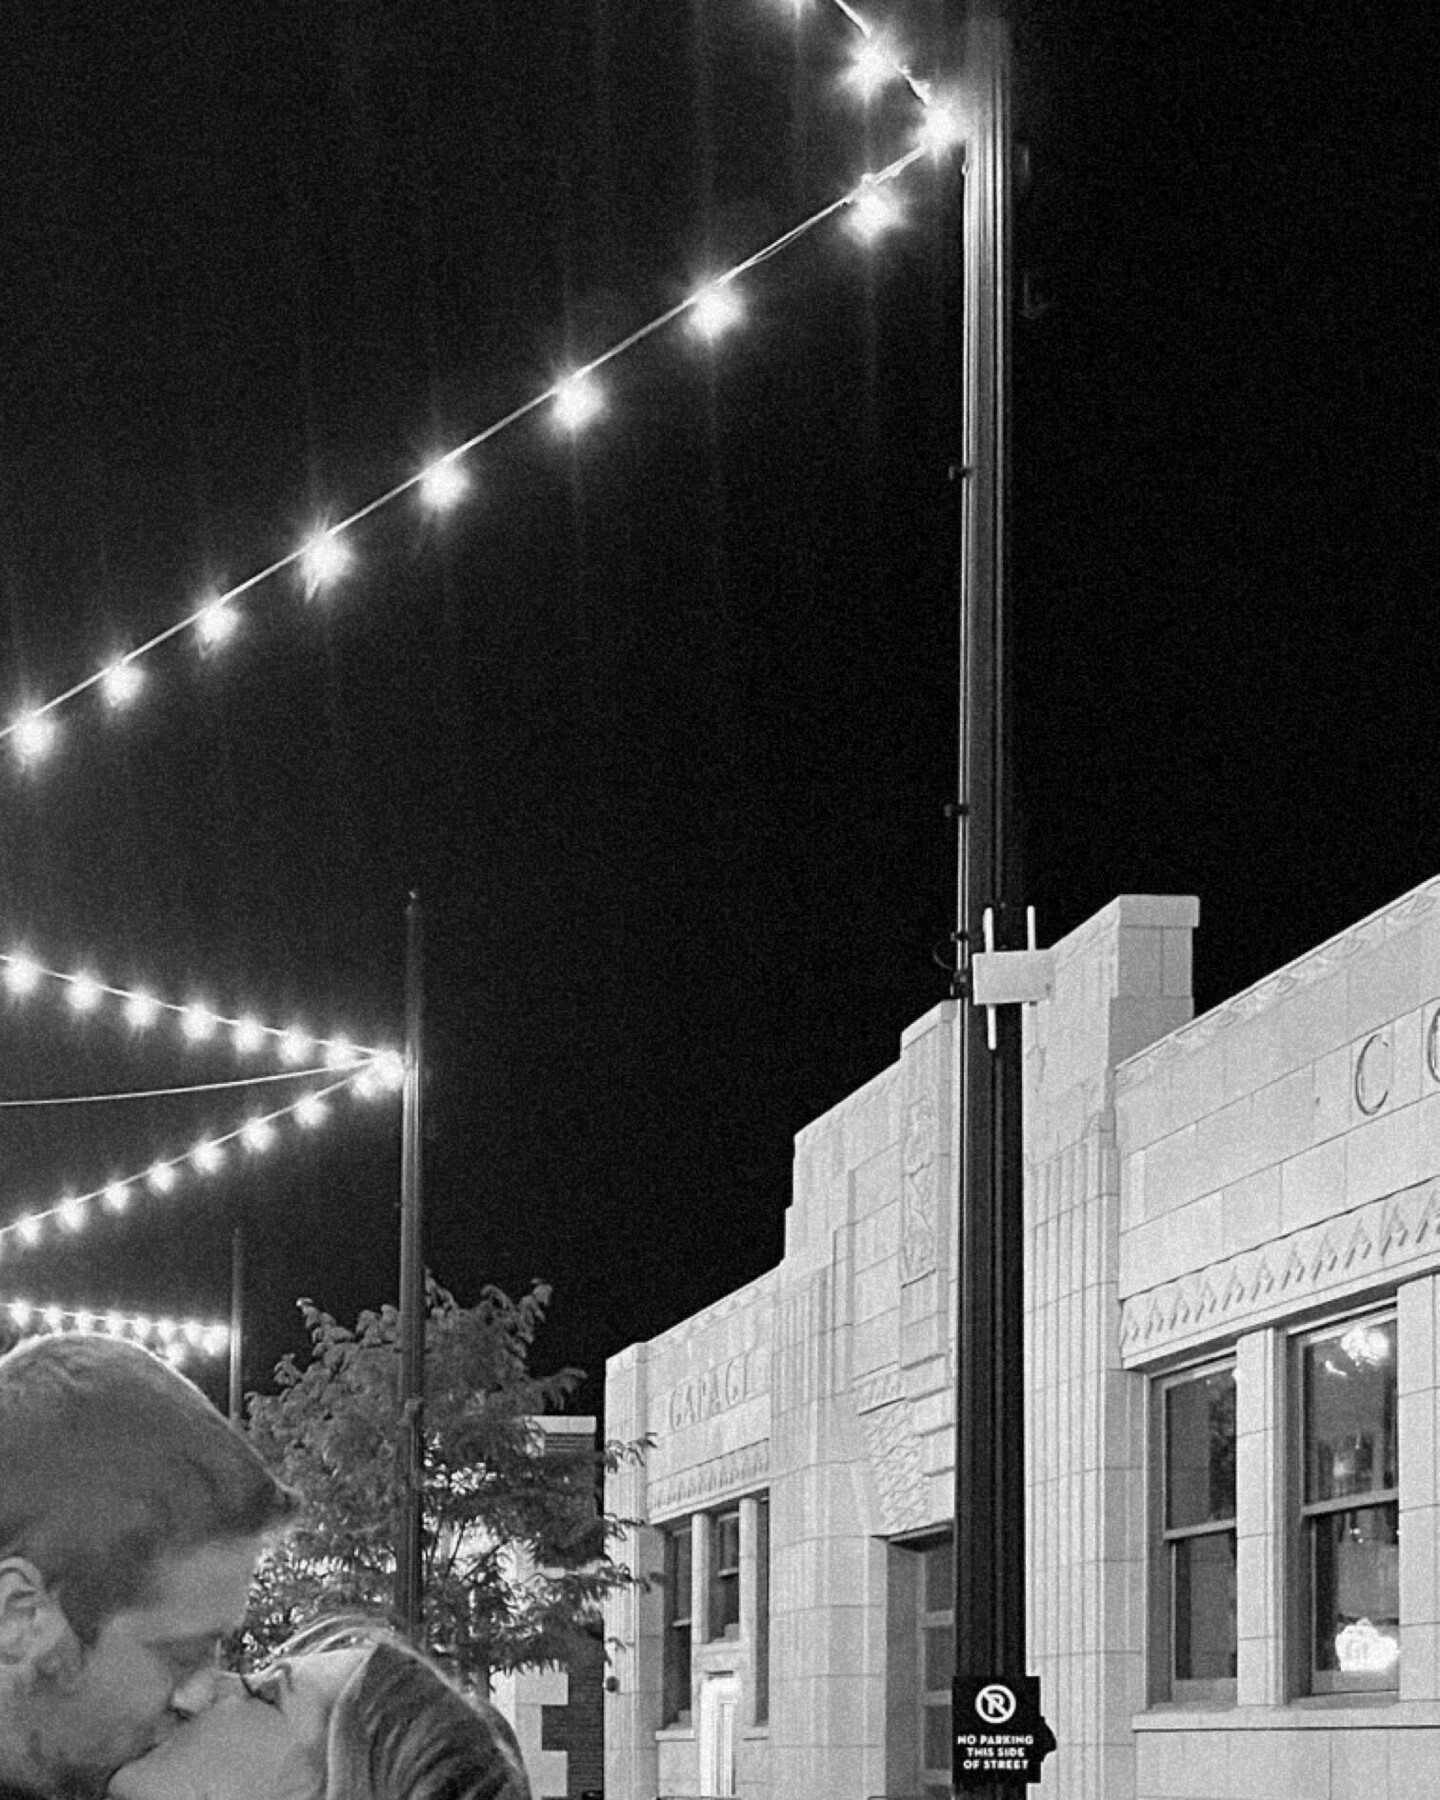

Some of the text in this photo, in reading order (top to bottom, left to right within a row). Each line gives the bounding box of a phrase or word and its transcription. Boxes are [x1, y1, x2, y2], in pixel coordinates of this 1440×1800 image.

[957, 1734, 1034, 1745] NO PARKING
[966, 1747, 1025, 1757] THIS SIDE
[963, 1759, 1029, 1770] OF STREET
